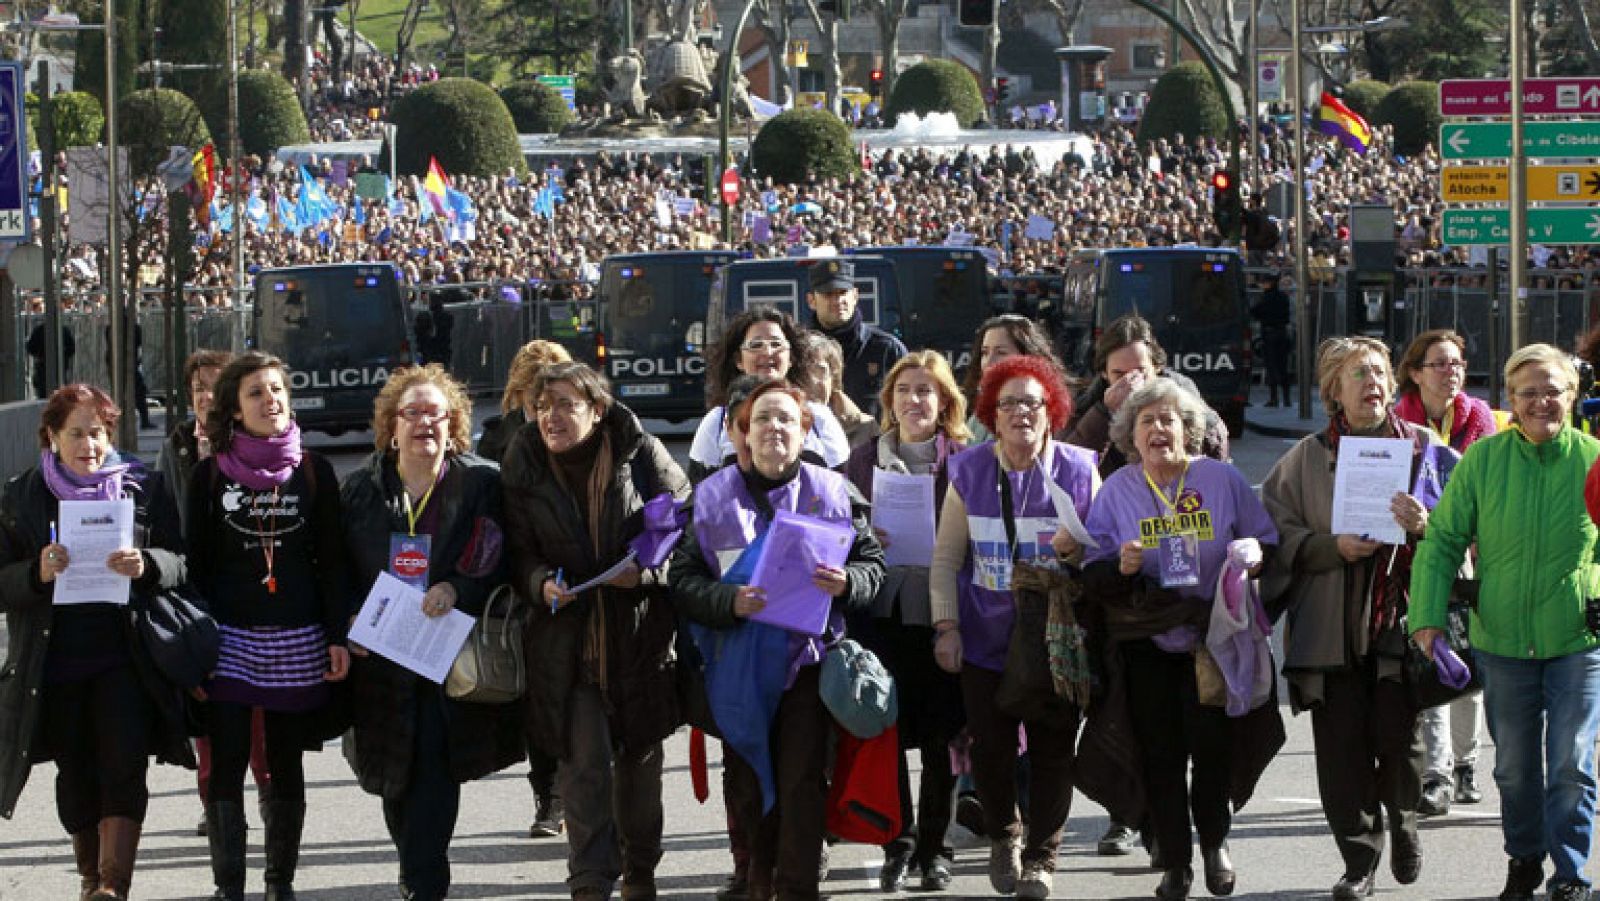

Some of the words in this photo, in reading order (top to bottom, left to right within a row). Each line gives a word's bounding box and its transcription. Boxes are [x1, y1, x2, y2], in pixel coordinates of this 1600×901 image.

[1503, 91, 1545, 103] Pdo
[1448, 183, 1497, 195] Atocha
[1544, 225, 1553, 237] V
[612, 356, 705, 378] POLIC
